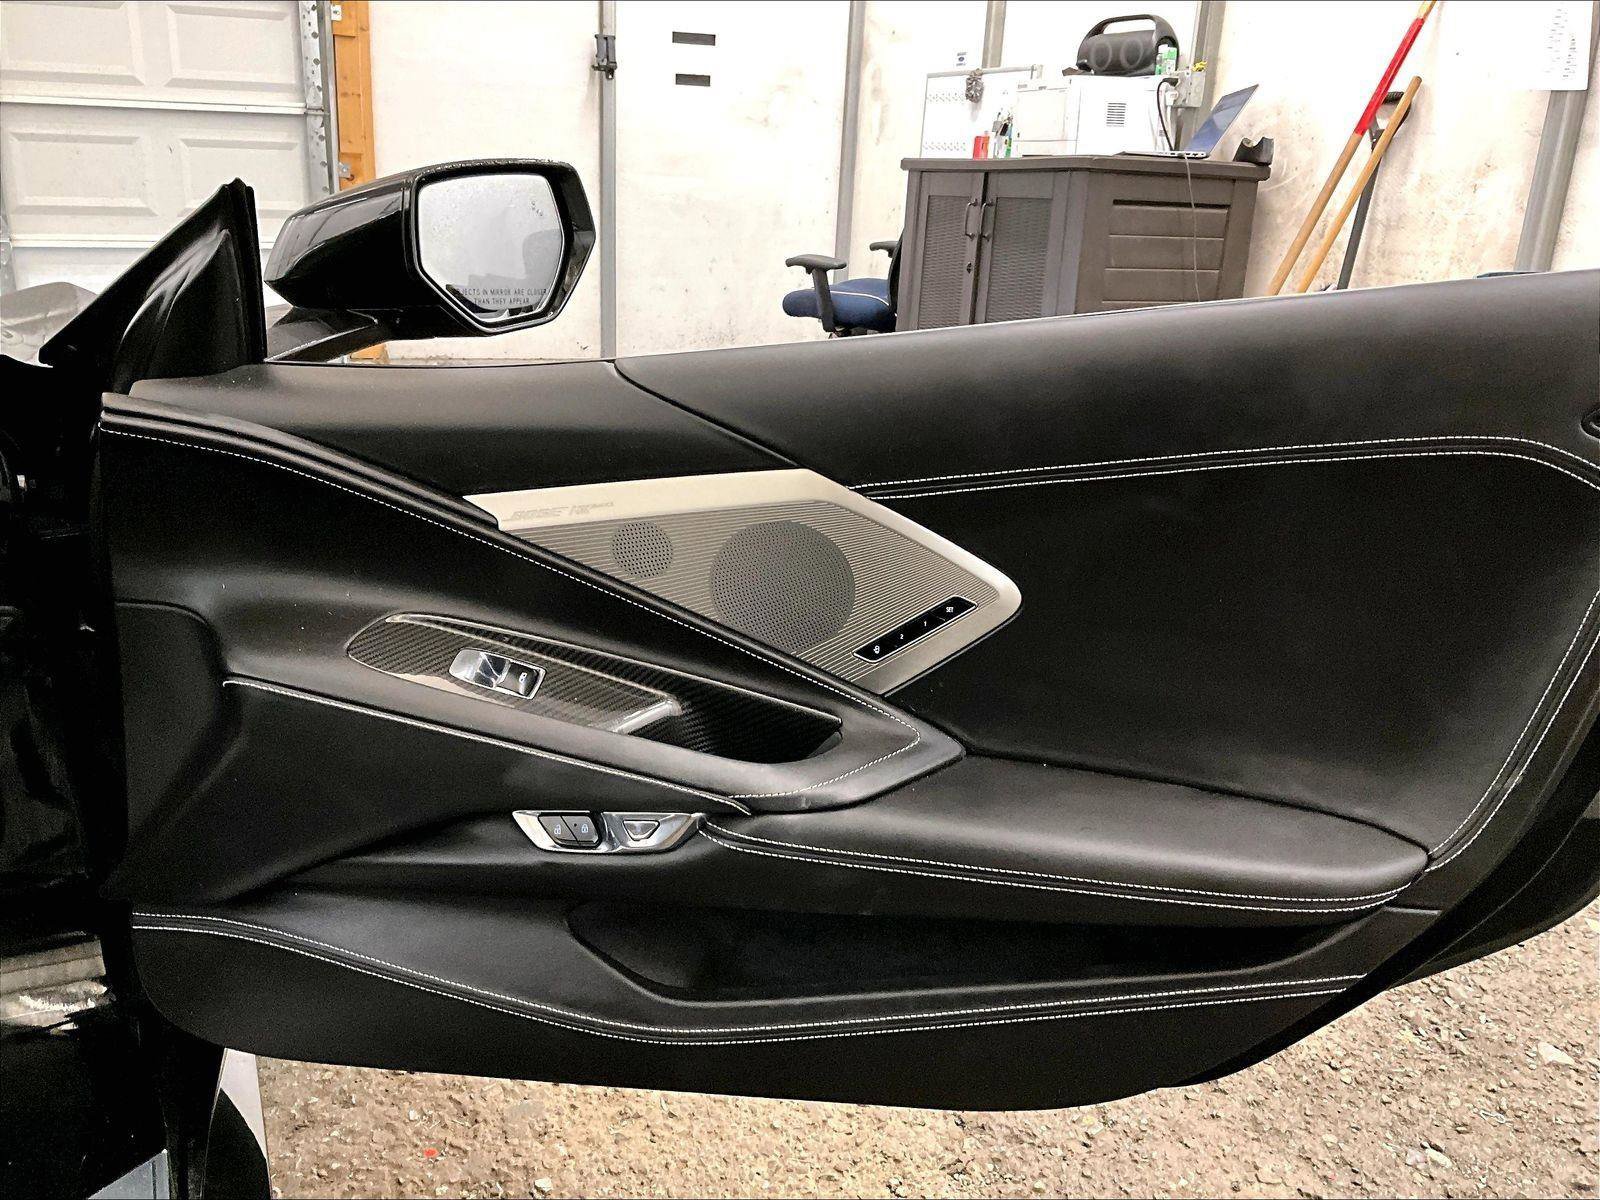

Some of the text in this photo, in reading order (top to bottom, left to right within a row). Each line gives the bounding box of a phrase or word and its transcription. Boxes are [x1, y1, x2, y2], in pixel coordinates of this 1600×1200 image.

[454, 288, 481, 296] JECTS
[482, 288, 489, 296] IN
[490, 288, 511, 296] MIRROR
[514, 288, 525, 296] ARE
